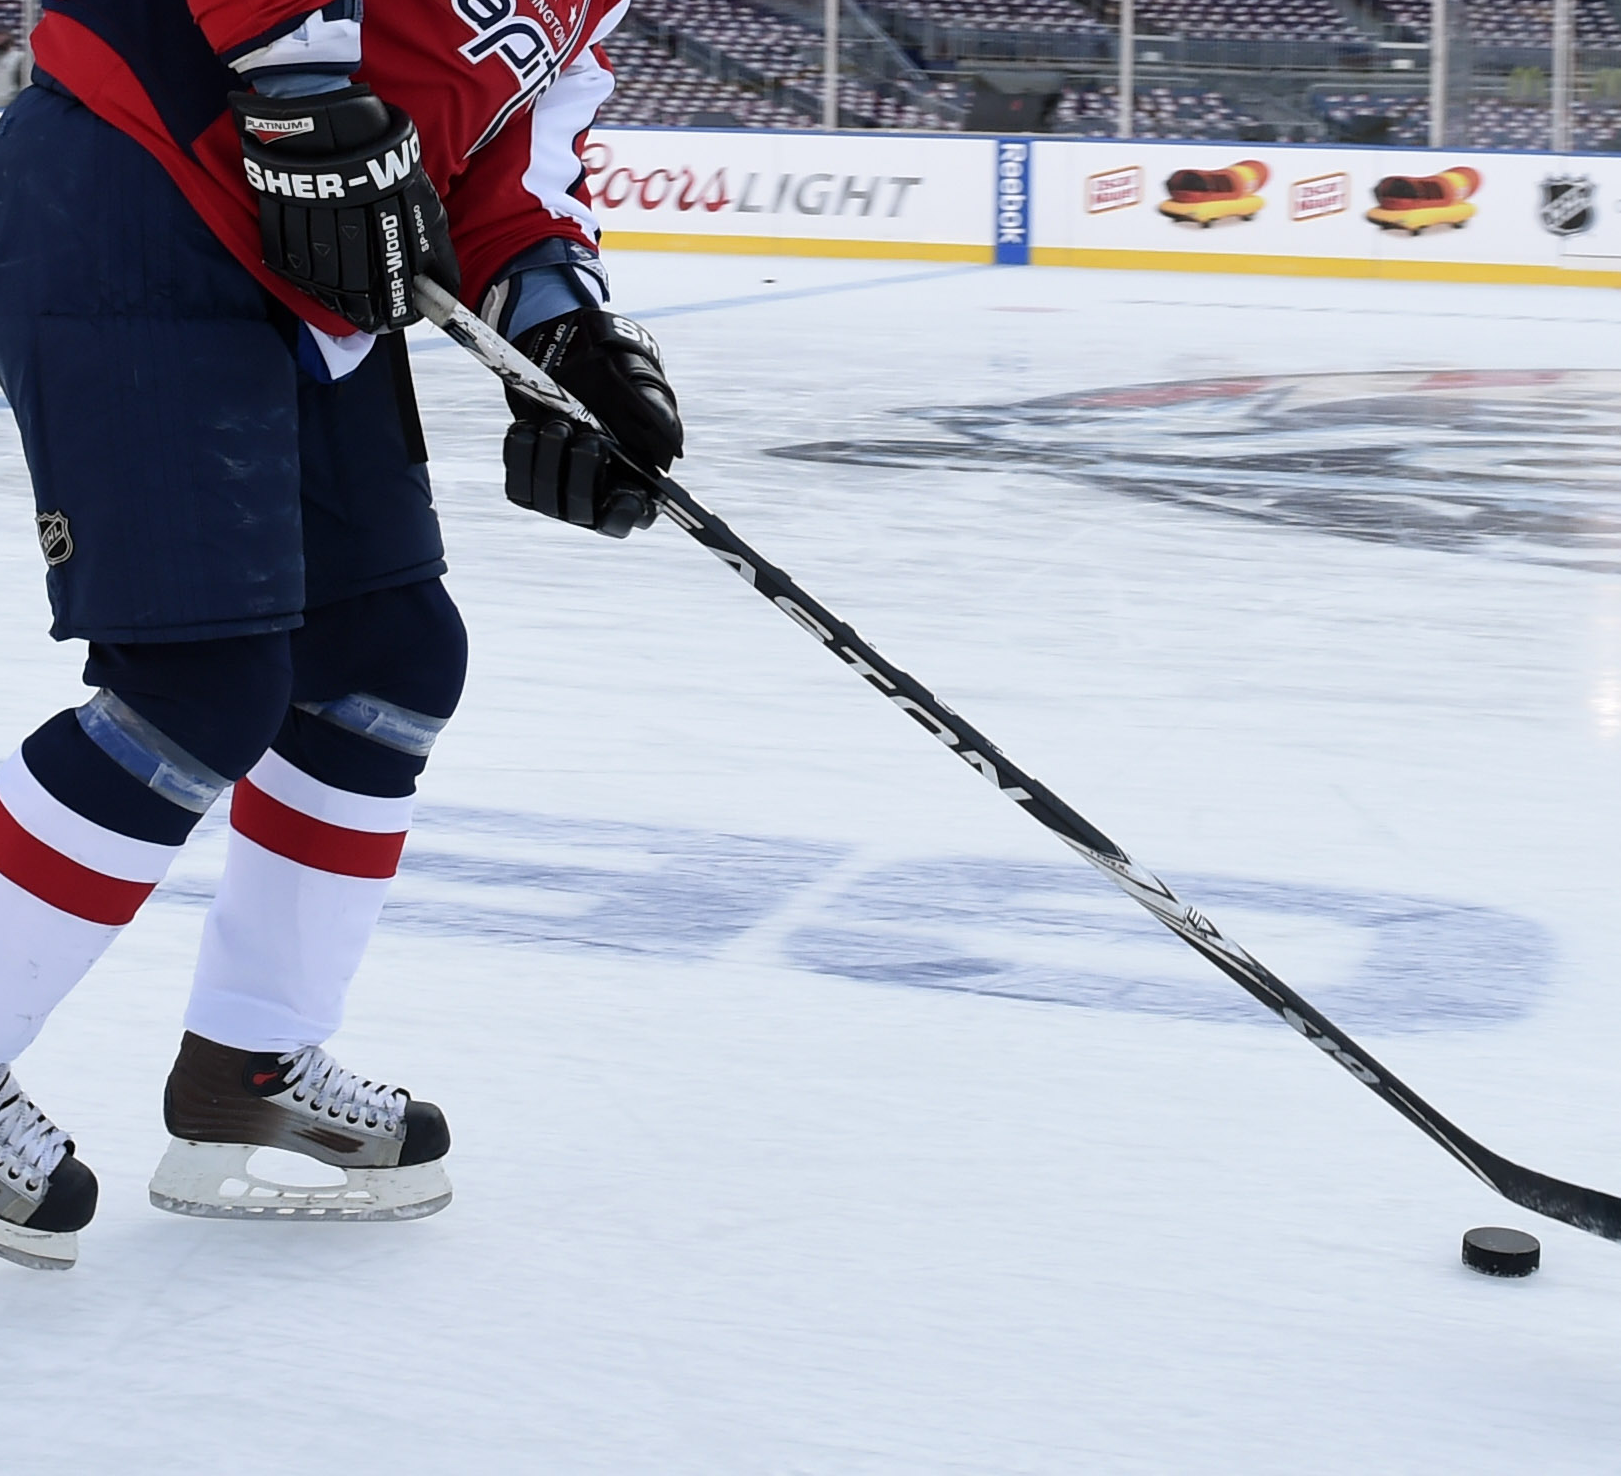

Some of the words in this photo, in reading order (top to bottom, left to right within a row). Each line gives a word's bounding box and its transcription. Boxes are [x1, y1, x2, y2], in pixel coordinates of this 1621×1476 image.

[734, 171, 923, 219] LIGHT
[998, 142, 1027, 246] Reebok
[552, 323, 568, 344] CUFF
